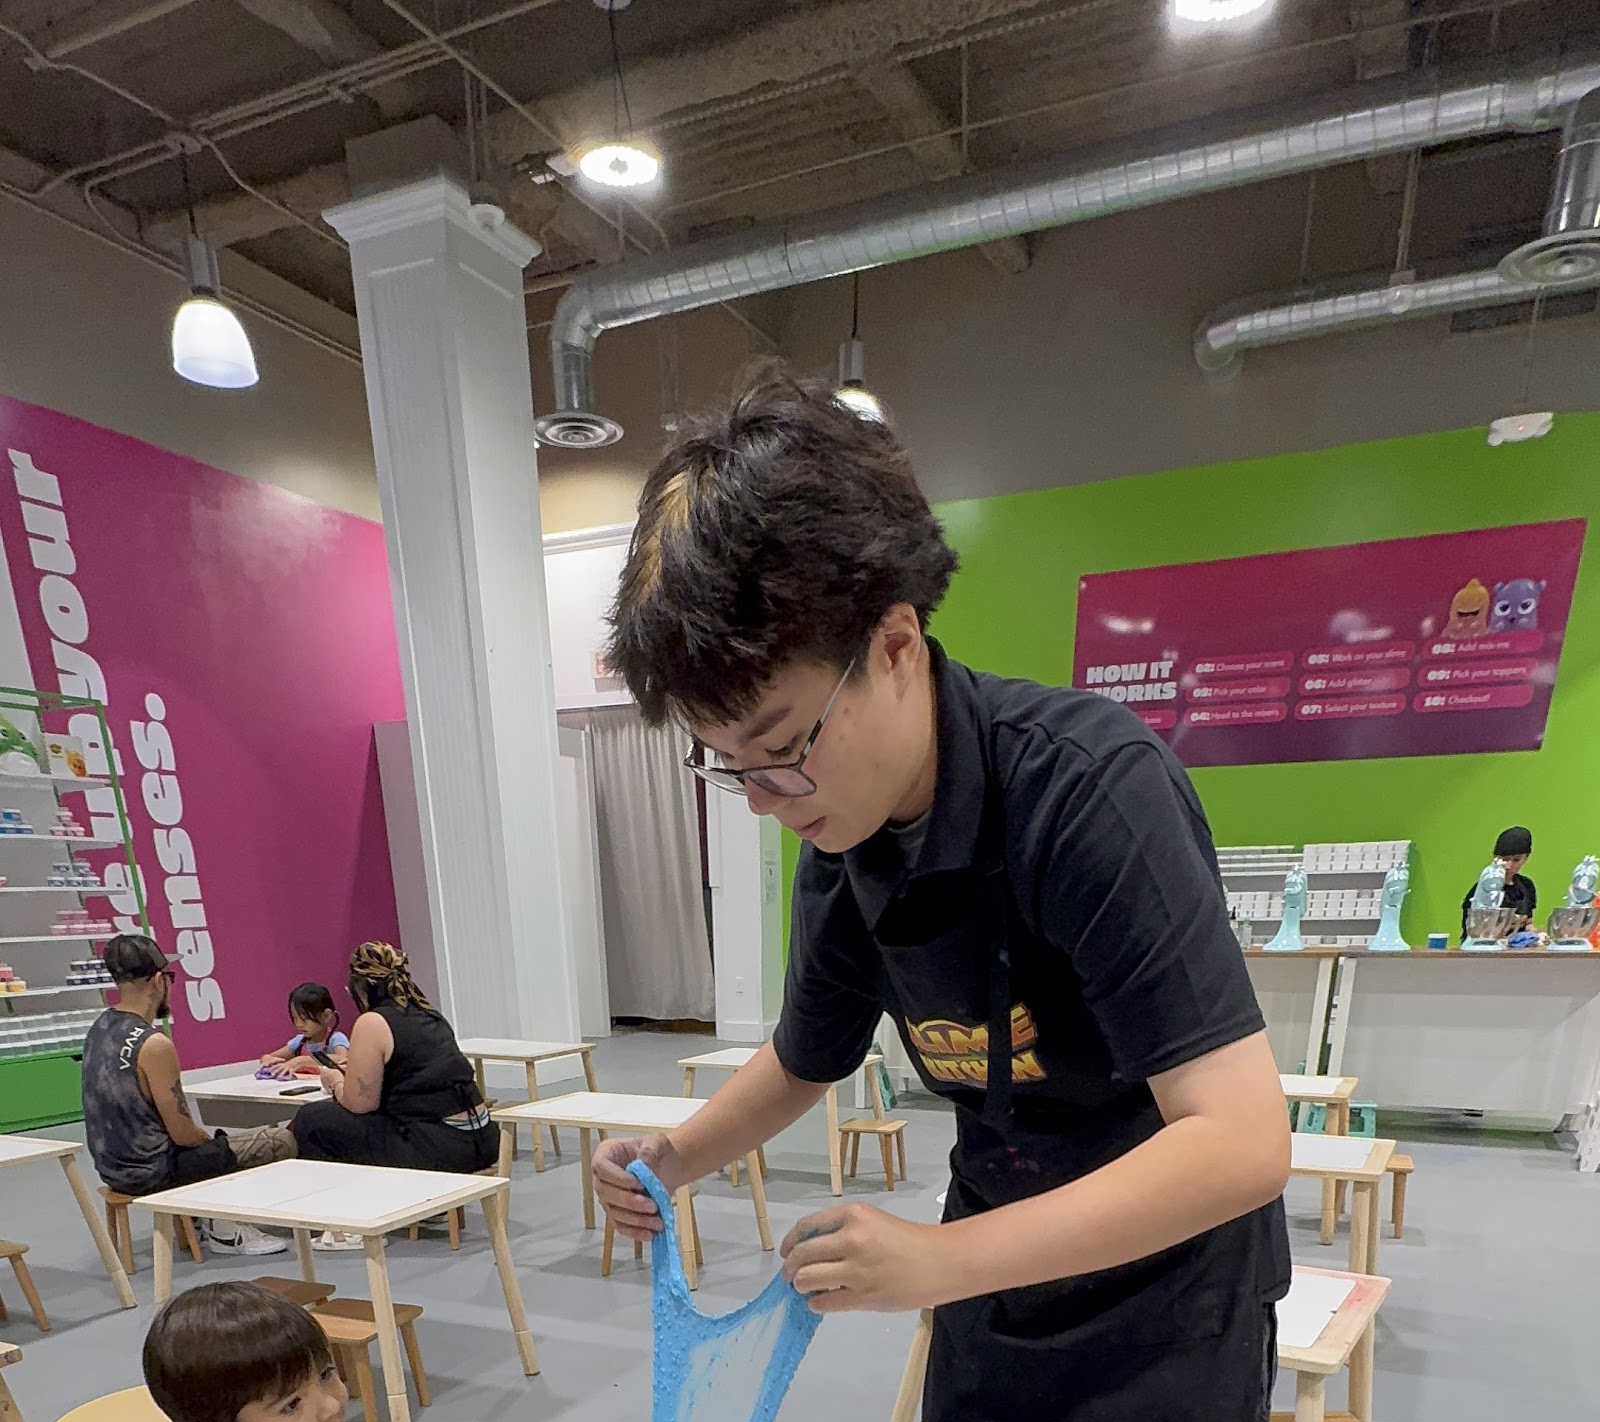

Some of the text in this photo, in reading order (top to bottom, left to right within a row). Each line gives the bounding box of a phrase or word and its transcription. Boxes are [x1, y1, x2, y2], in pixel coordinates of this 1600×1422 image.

[8, 449, 109, 706] your
[1086, 660, 1174, 684] HOW IT
[130, 691, 226, 1023] senses.
[118, 1026, 145, 1071] RVCA
[905, 1003, 1039, 1053] LIME
